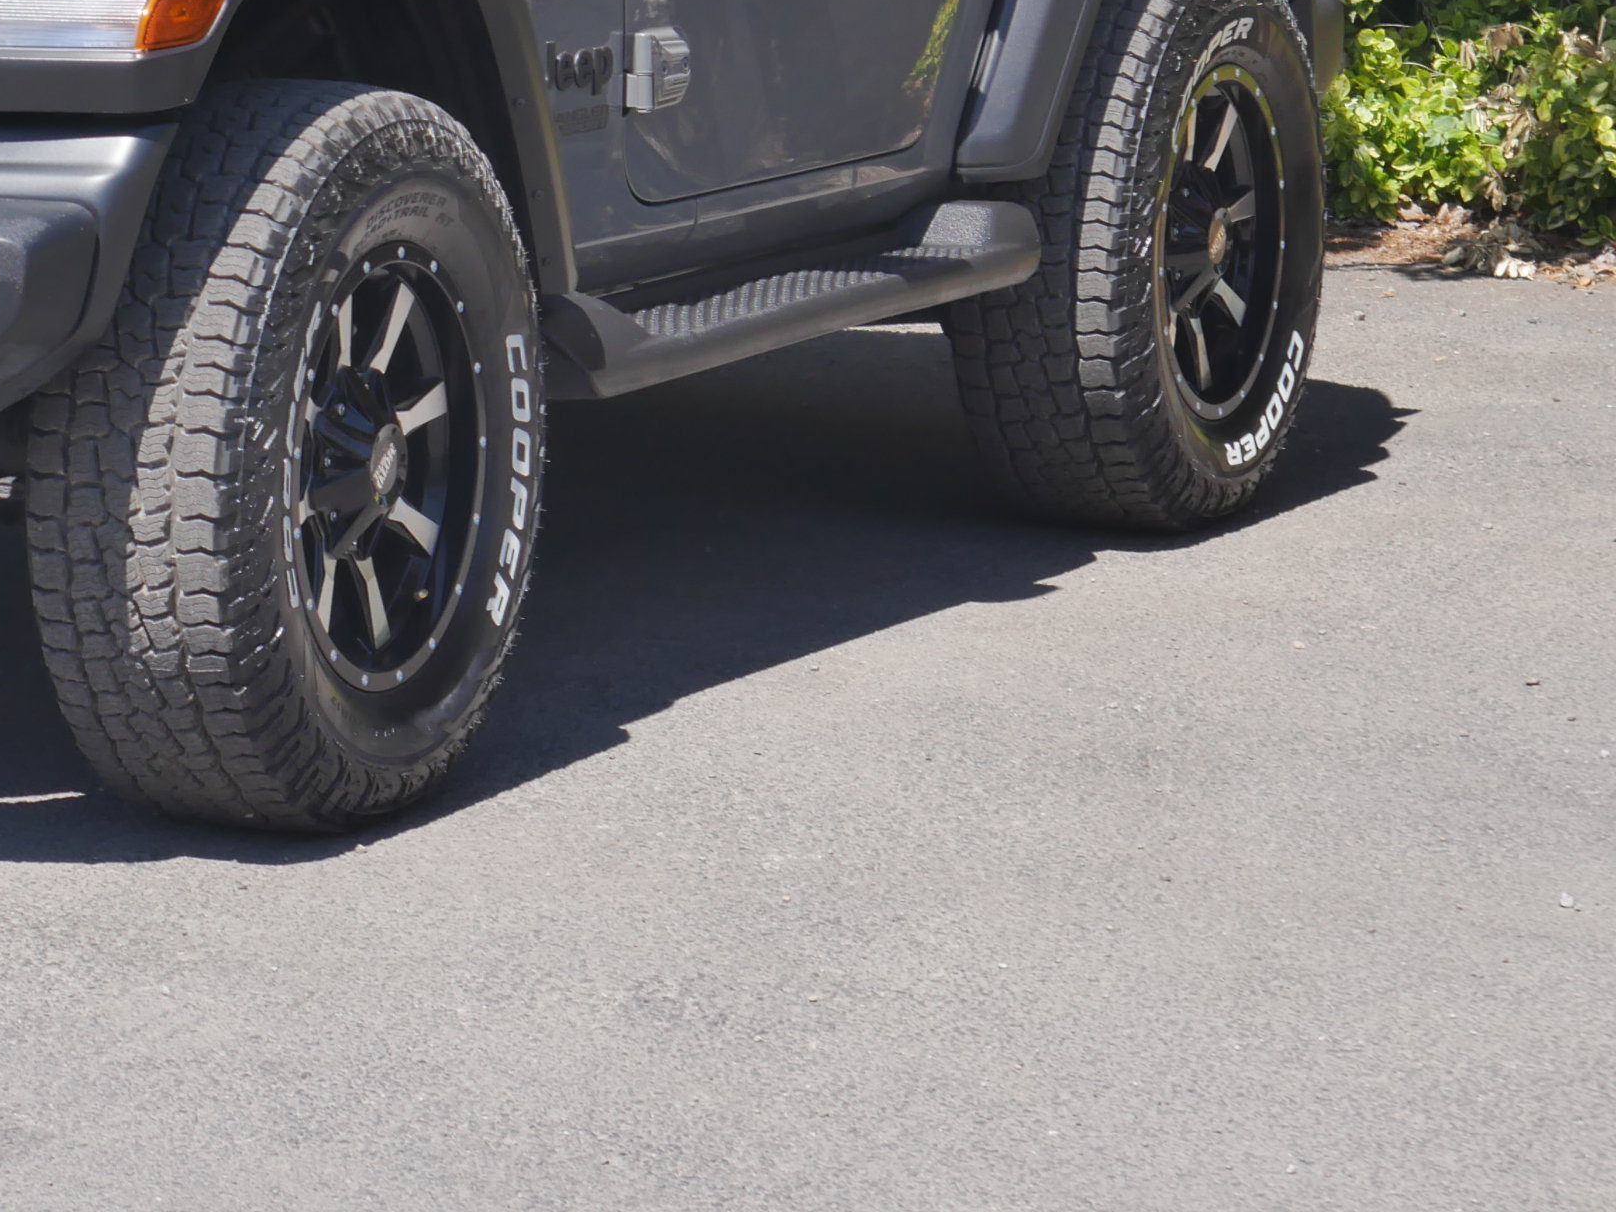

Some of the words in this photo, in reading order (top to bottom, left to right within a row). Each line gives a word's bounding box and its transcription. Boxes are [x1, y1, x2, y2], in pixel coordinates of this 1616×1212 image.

[545, 40, 614, 96] Jeep
[1172, 17, 1254, 154] COOPER
[366, 191, 447, 229] DISCOVERER
[1224, 330, 1304, 466] COOPER
[486, 334, 532, 627] COOPER
